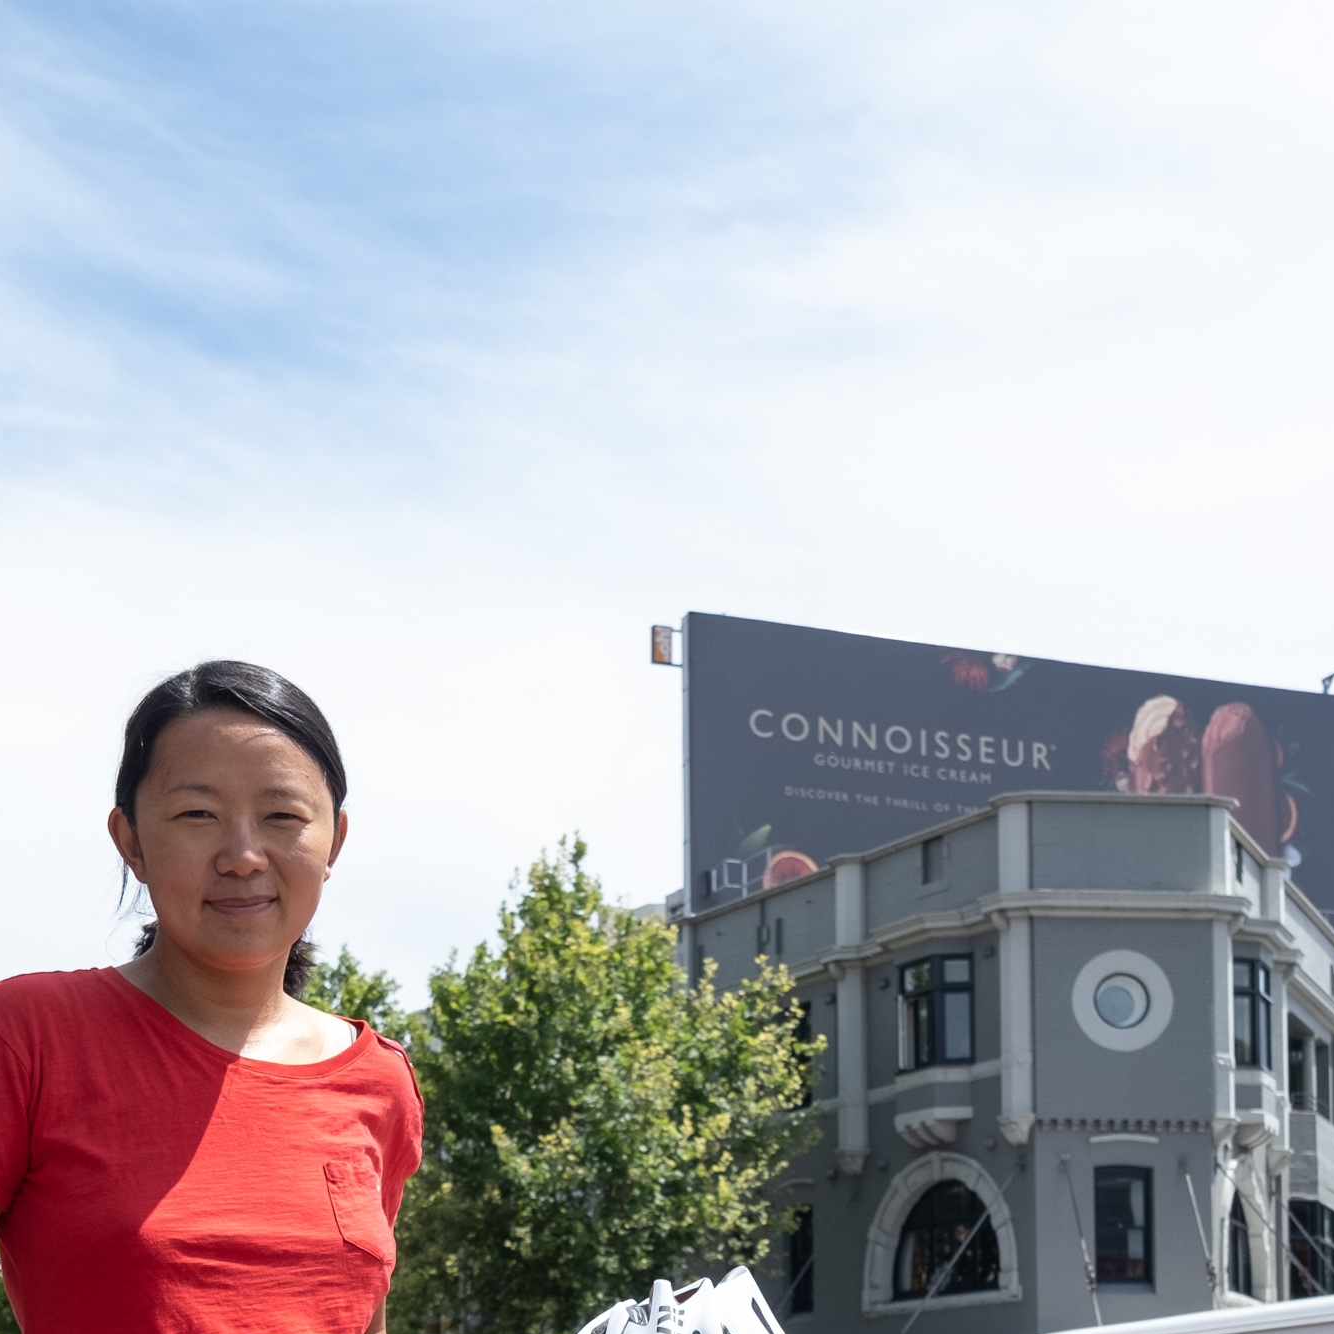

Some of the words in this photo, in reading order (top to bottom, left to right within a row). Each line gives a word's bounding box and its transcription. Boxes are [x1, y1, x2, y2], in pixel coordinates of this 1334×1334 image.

[749, 708, 1052, 770] CONNOISSEUR
[813, 752, 895, 775] GOURMET
[903, 763, 930, 779] ICE
[936, 767, 992, 785] CREAM
[784, 785, 849, 803] DISCOVER
[854, 793, 879, 806] THE
[885, 796, 929, 813] THRILL
[933, 803, 951, 814] OF
